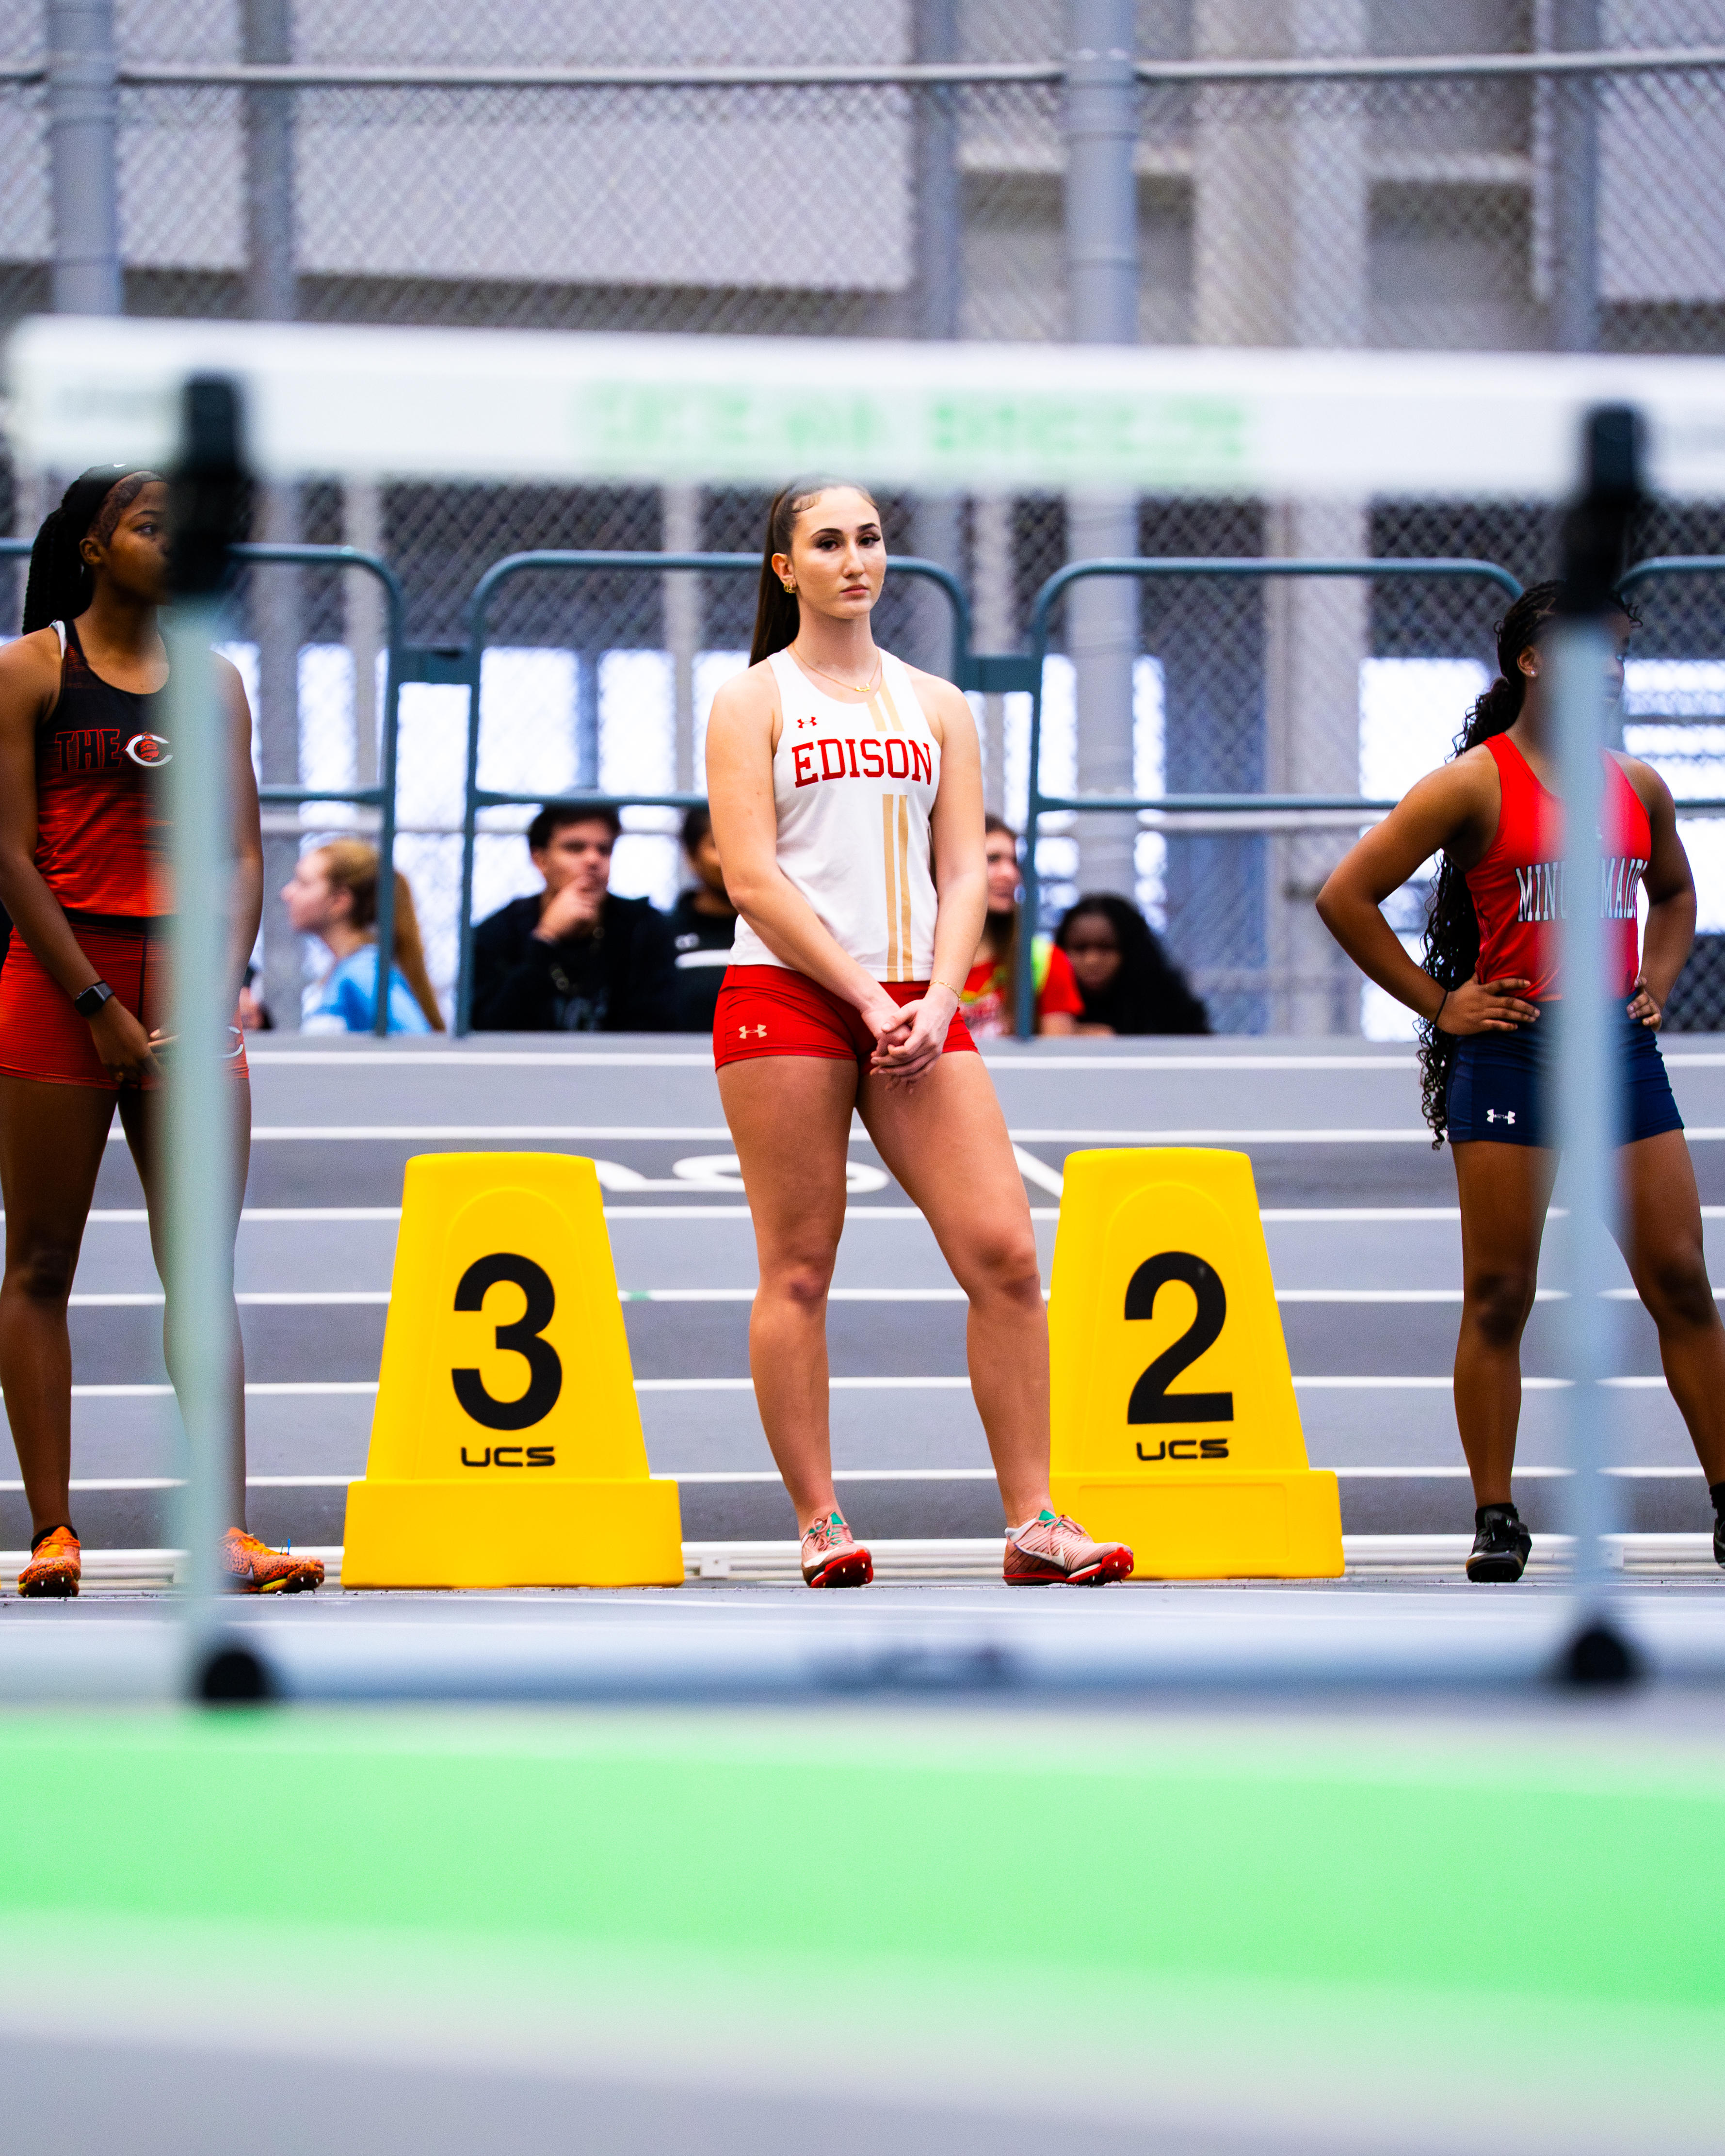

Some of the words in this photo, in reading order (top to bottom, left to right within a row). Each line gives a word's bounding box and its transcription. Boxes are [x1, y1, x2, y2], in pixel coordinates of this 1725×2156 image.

[55, 728, 123, 772] THE
[791, 739, 932, 788] EDISON
[451, 1252, 563, 1431] 3
[1124, 1251, 1234, 1425] 2
[461, 1446, 556, 1467] UCS
[1136, 1438, 1230, 1461] UCS
